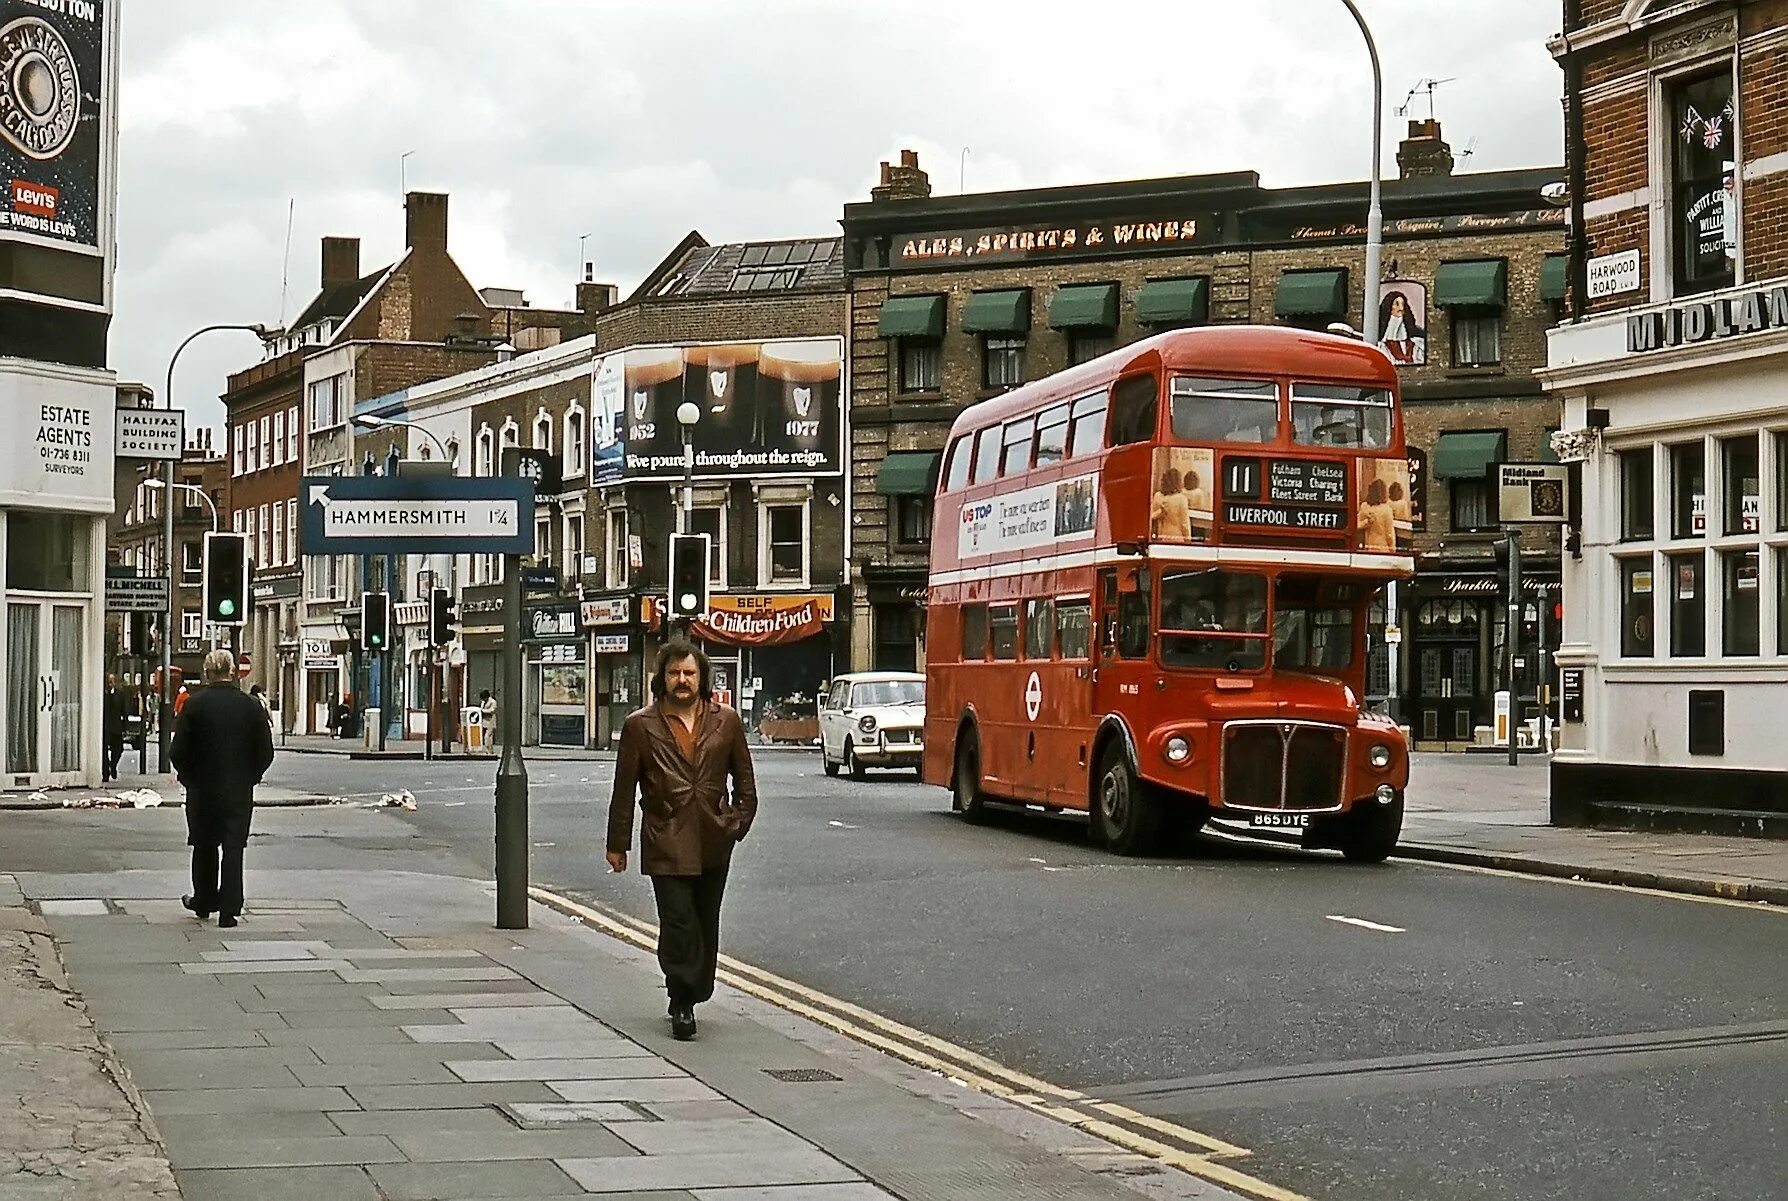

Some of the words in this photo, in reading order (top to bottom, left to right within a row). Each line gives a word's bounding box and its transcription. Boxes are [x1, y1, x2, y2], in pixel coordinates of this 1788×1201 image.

[10, 212, 39, 229] WORD
[39, 218, 49, 232] IS
[1515, 210, 1530, 224] of
[1700, 215, 1724, 231] WILLIA
[1085, 227, 1104, 246] &
[1112, 219, 1197, 244] WINES
[1591, 260, 1635, 279] HARWOOD
[1593, 279, 1616, 294] ROAD
[41, 405, 90, 426] ESTATE
[123, 416, 178, 426] HALIFAX
[36, 426, 91, 447] AGENTS
[123, 428, 177, 439] BUILDING
[122, 441, 176, 451] SOCIETY
[40, 447, 70, 460] 01-736
[73, 450, 90, 463] 8311
[696, 448, 767, 469] throughout
[769, 447, 790, 465] the
[790, 449, 828, 469] reign.
[45, 463, 84, 476] SURVEYORS
[1272, 463, 1302, 476] Fulham
[1312, 465, 1343, 478] Chelsea
[1503, 467, 1545, 478] Midland
[1231, 465, 1251, 493] 11
[1271, 475, 1303, 488] Victoria
[1310, 478, 1338, 492] Charing
[1503, 478, 1529, 487] Bank
[1271, 488, 1292, 500] Fleet
[1293, 489, 1318, 501] Street
[1325, 492, 1344, 503] Bank
[333, 511, 466, 524] HAMMERSMITH
[975, 504, 992, 520] TOP
[1229, 507, 1289, 525] LIVERPOOL
[1297, 511, 1338, 528] STREET
[1443, 579, 1500, 593] Sparklin
[737, 598, 773, 608] SELF
[709, 611, 774, 633] Children
[775, 604, 813, 630] Fund
